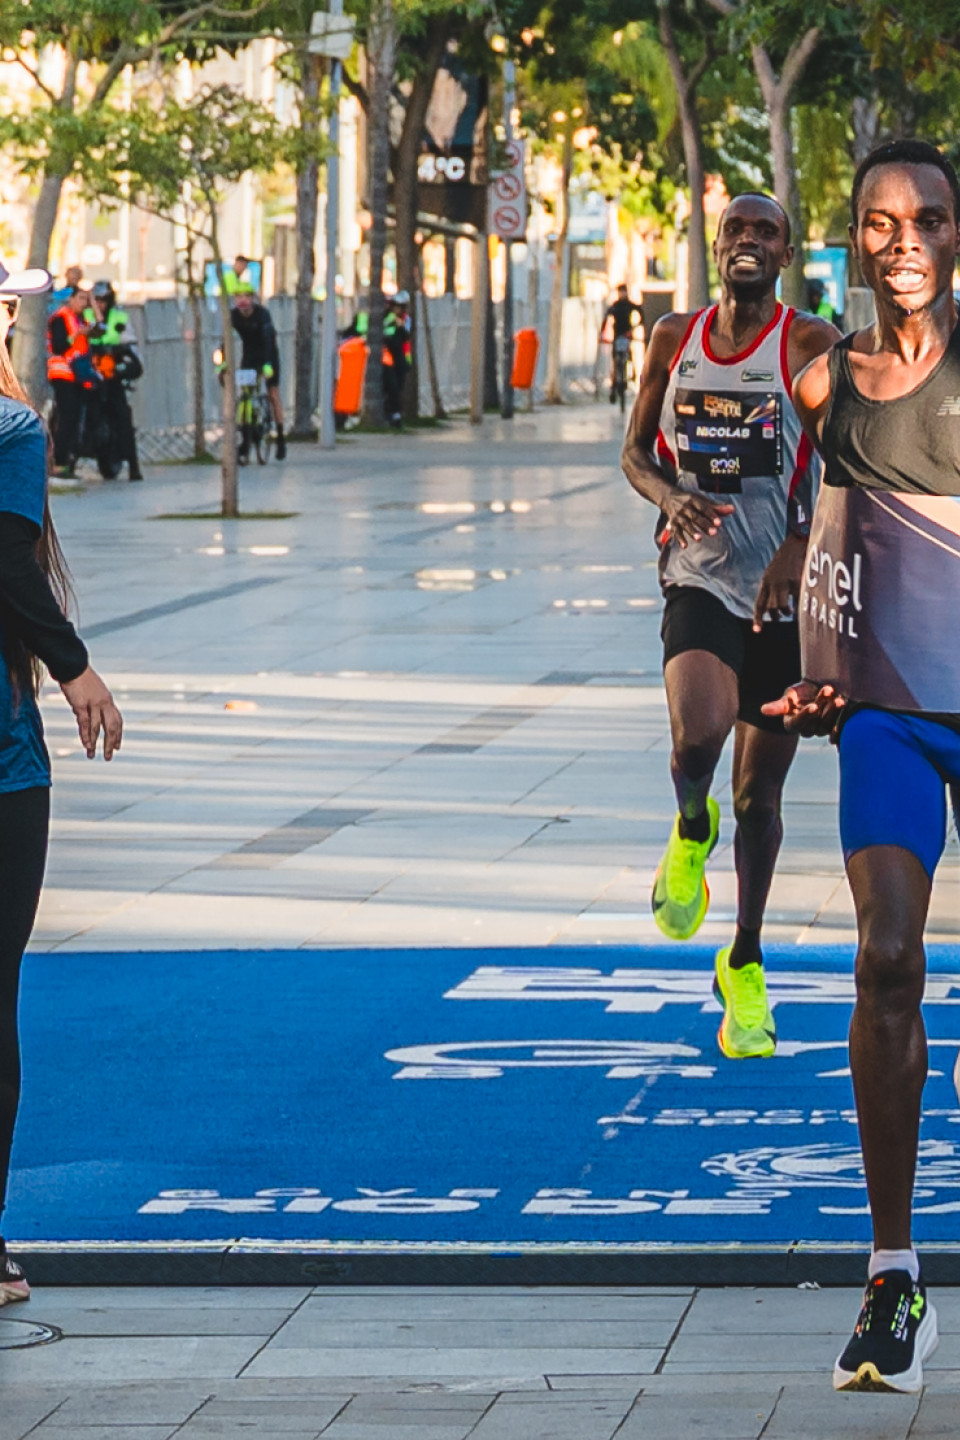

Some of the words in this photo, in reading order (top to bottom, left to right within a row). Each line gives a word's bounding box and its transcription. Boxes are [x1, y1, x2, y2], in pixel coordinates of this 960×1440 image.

[695, 426, 751, 439] NICOLAS
[805, 543, 863, 611] enel
[801, 591, 859, 639] BRASIL
[157, 1187, 790, 1199] GOVERNO
[137, 1197, 481, 1215] RIO
[520, 1197, 773, 1215] DE
